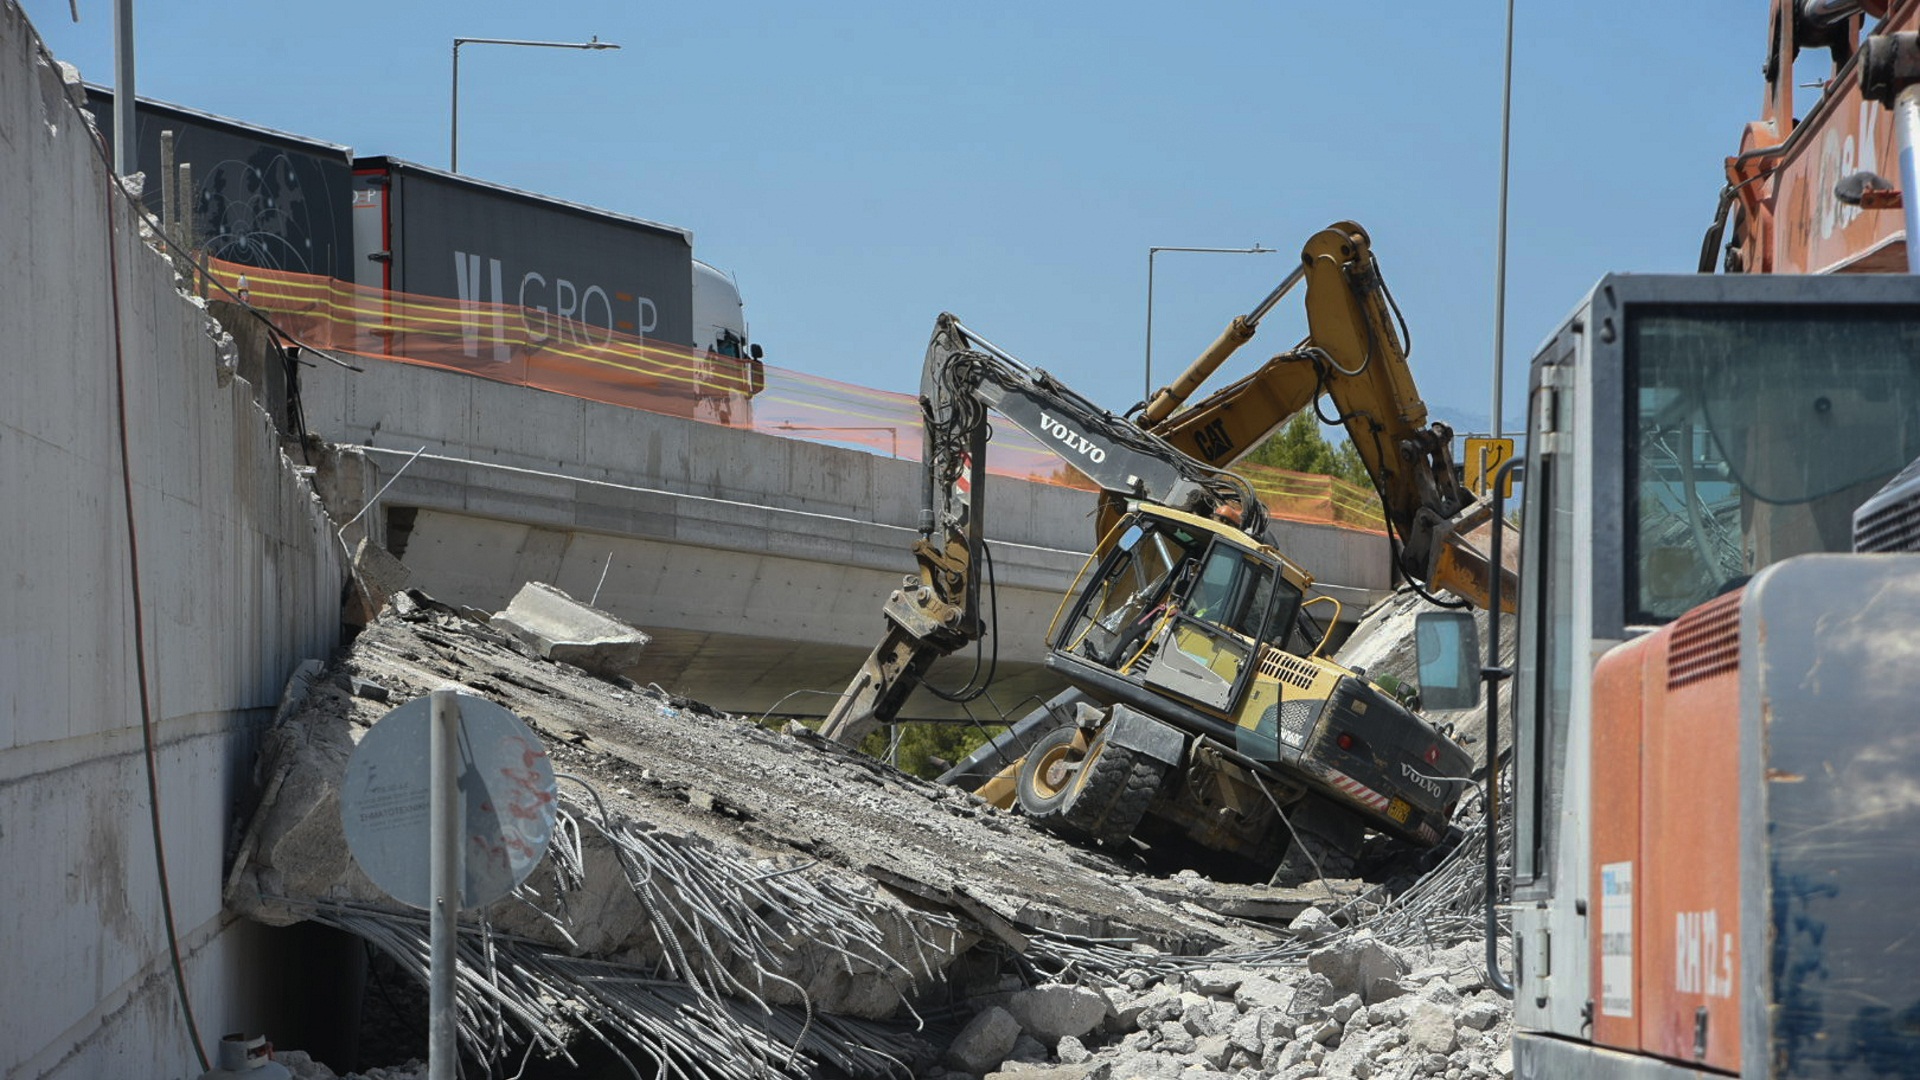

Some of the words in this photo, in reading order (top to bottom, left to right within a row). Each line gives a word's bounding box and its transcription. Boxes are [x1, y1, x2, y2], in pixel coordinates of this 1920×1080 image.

[1040, 411, 1106, 464] VOLVO
[1194, 417, 1234, 461] CAT
[1400, 761, 1442, 799] VOLVO
